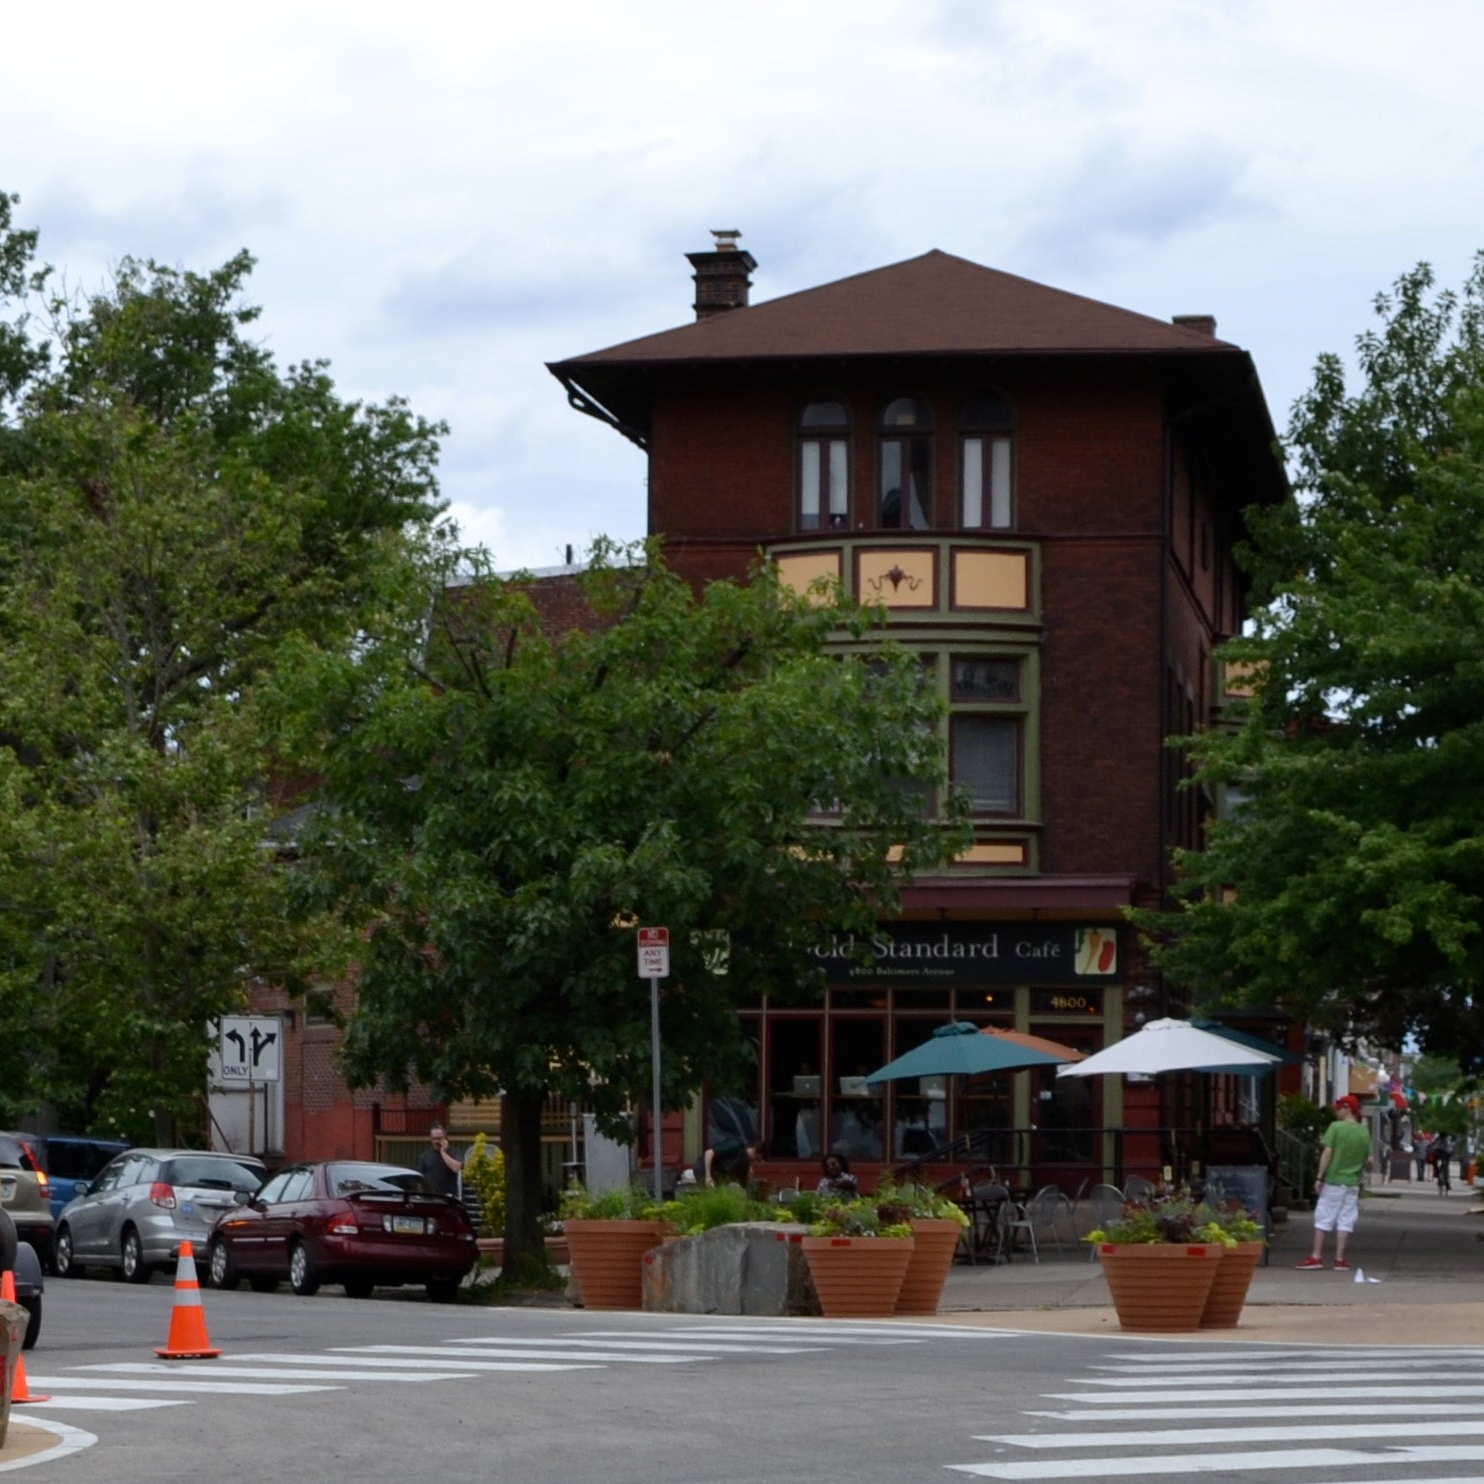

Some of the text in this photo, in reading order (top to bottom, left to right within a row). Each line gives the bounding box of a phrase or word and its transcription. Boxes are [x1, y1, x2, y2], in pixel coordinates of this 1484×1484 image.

[873, 933, 998, 958] Standard
[1016, 941, 1061, 958] Café
[644, 958, 663, 966] TIME
[876, 966, 919, 976] Baltimore
[921, 966, 955, 976] Avenue
[224, 1066, 248, 1076] ONLY
